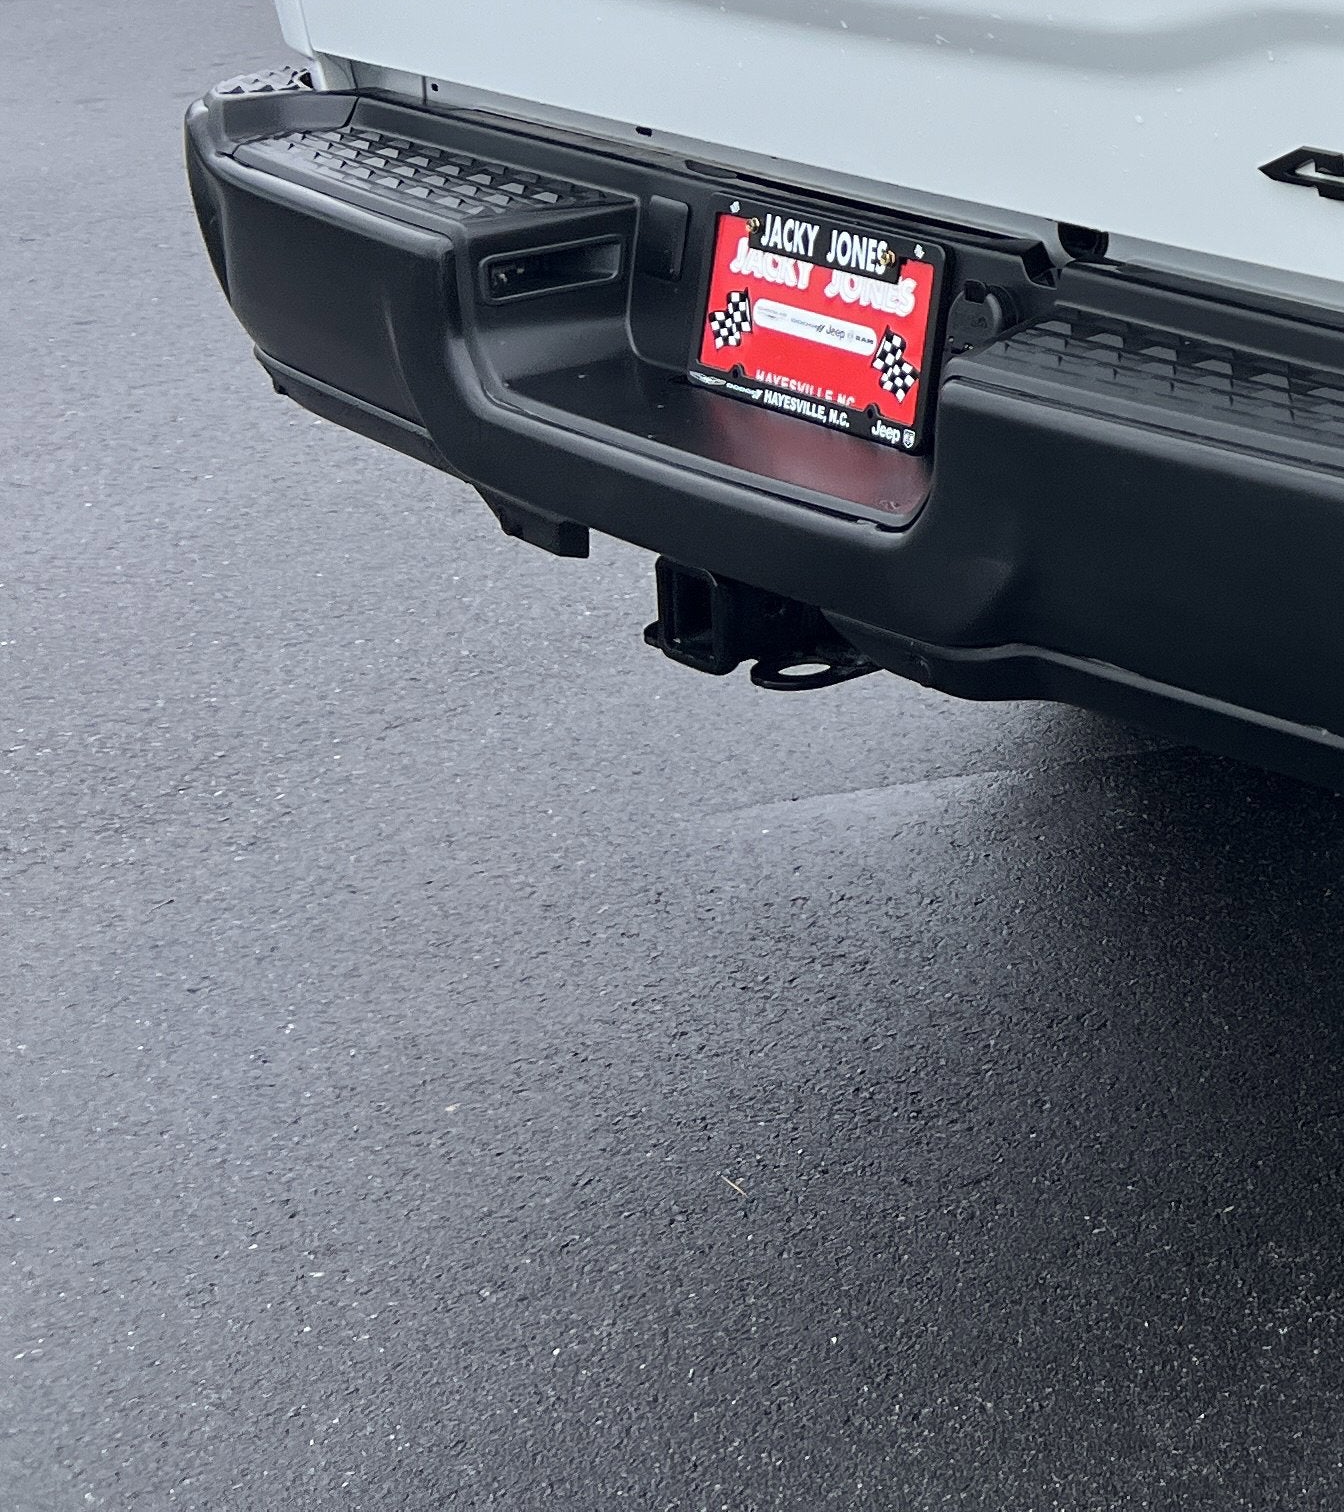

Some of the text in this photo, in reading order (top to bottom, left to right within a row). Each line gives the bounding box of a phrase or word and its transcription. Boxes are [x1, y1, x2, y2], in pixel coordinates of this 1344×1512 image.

[761, 213, 889, 276] JACKY JONES
[730, 237, 918, 318] JACKY JONES
[826, 324, 845, 340] Jeep
[828, 408, 850, 428] N.C.
[871, 419, 901, 444] Jeep
